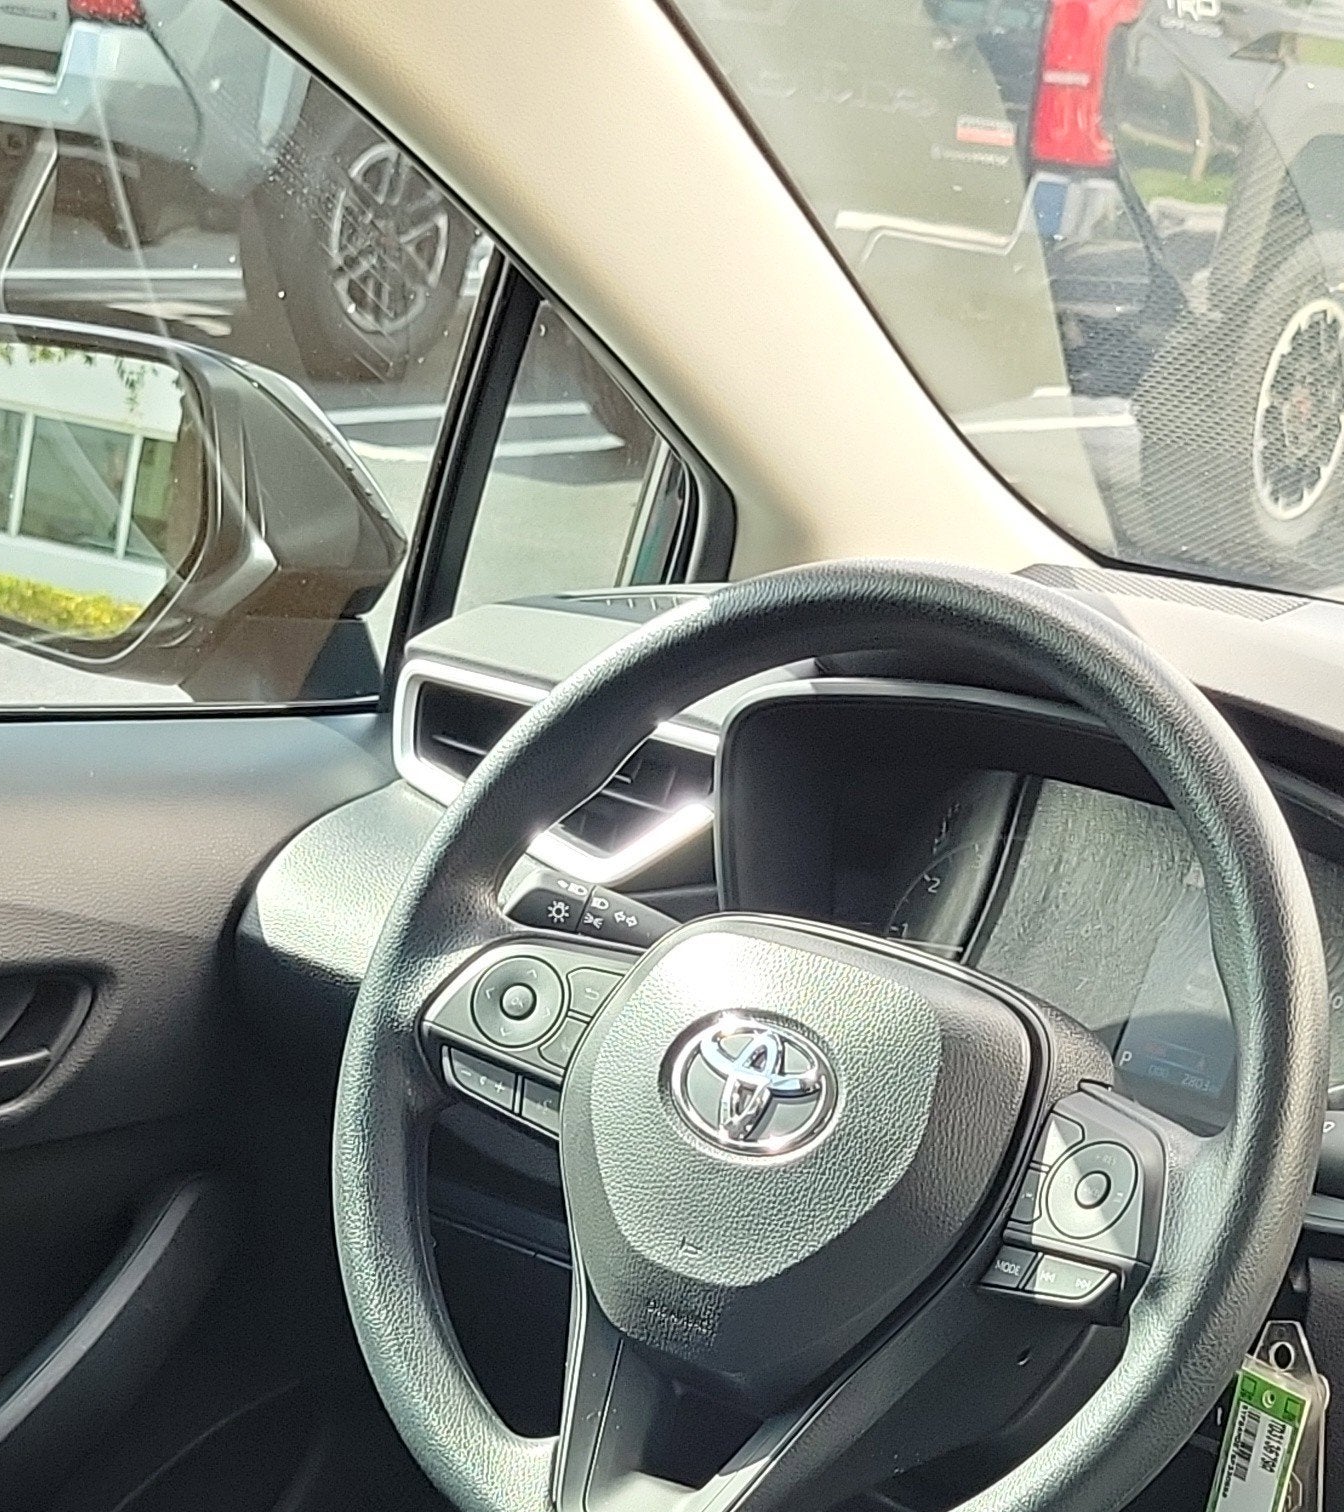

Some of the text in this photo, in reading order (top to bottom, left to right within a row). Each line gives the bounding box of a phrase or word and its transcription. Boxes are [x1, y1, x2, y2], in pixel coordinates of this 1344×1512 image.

[928, 877, 940, 893] 2
[1119, 1050, 1132, 1066] P
[995, 1260, 1021, 1276] MODE
